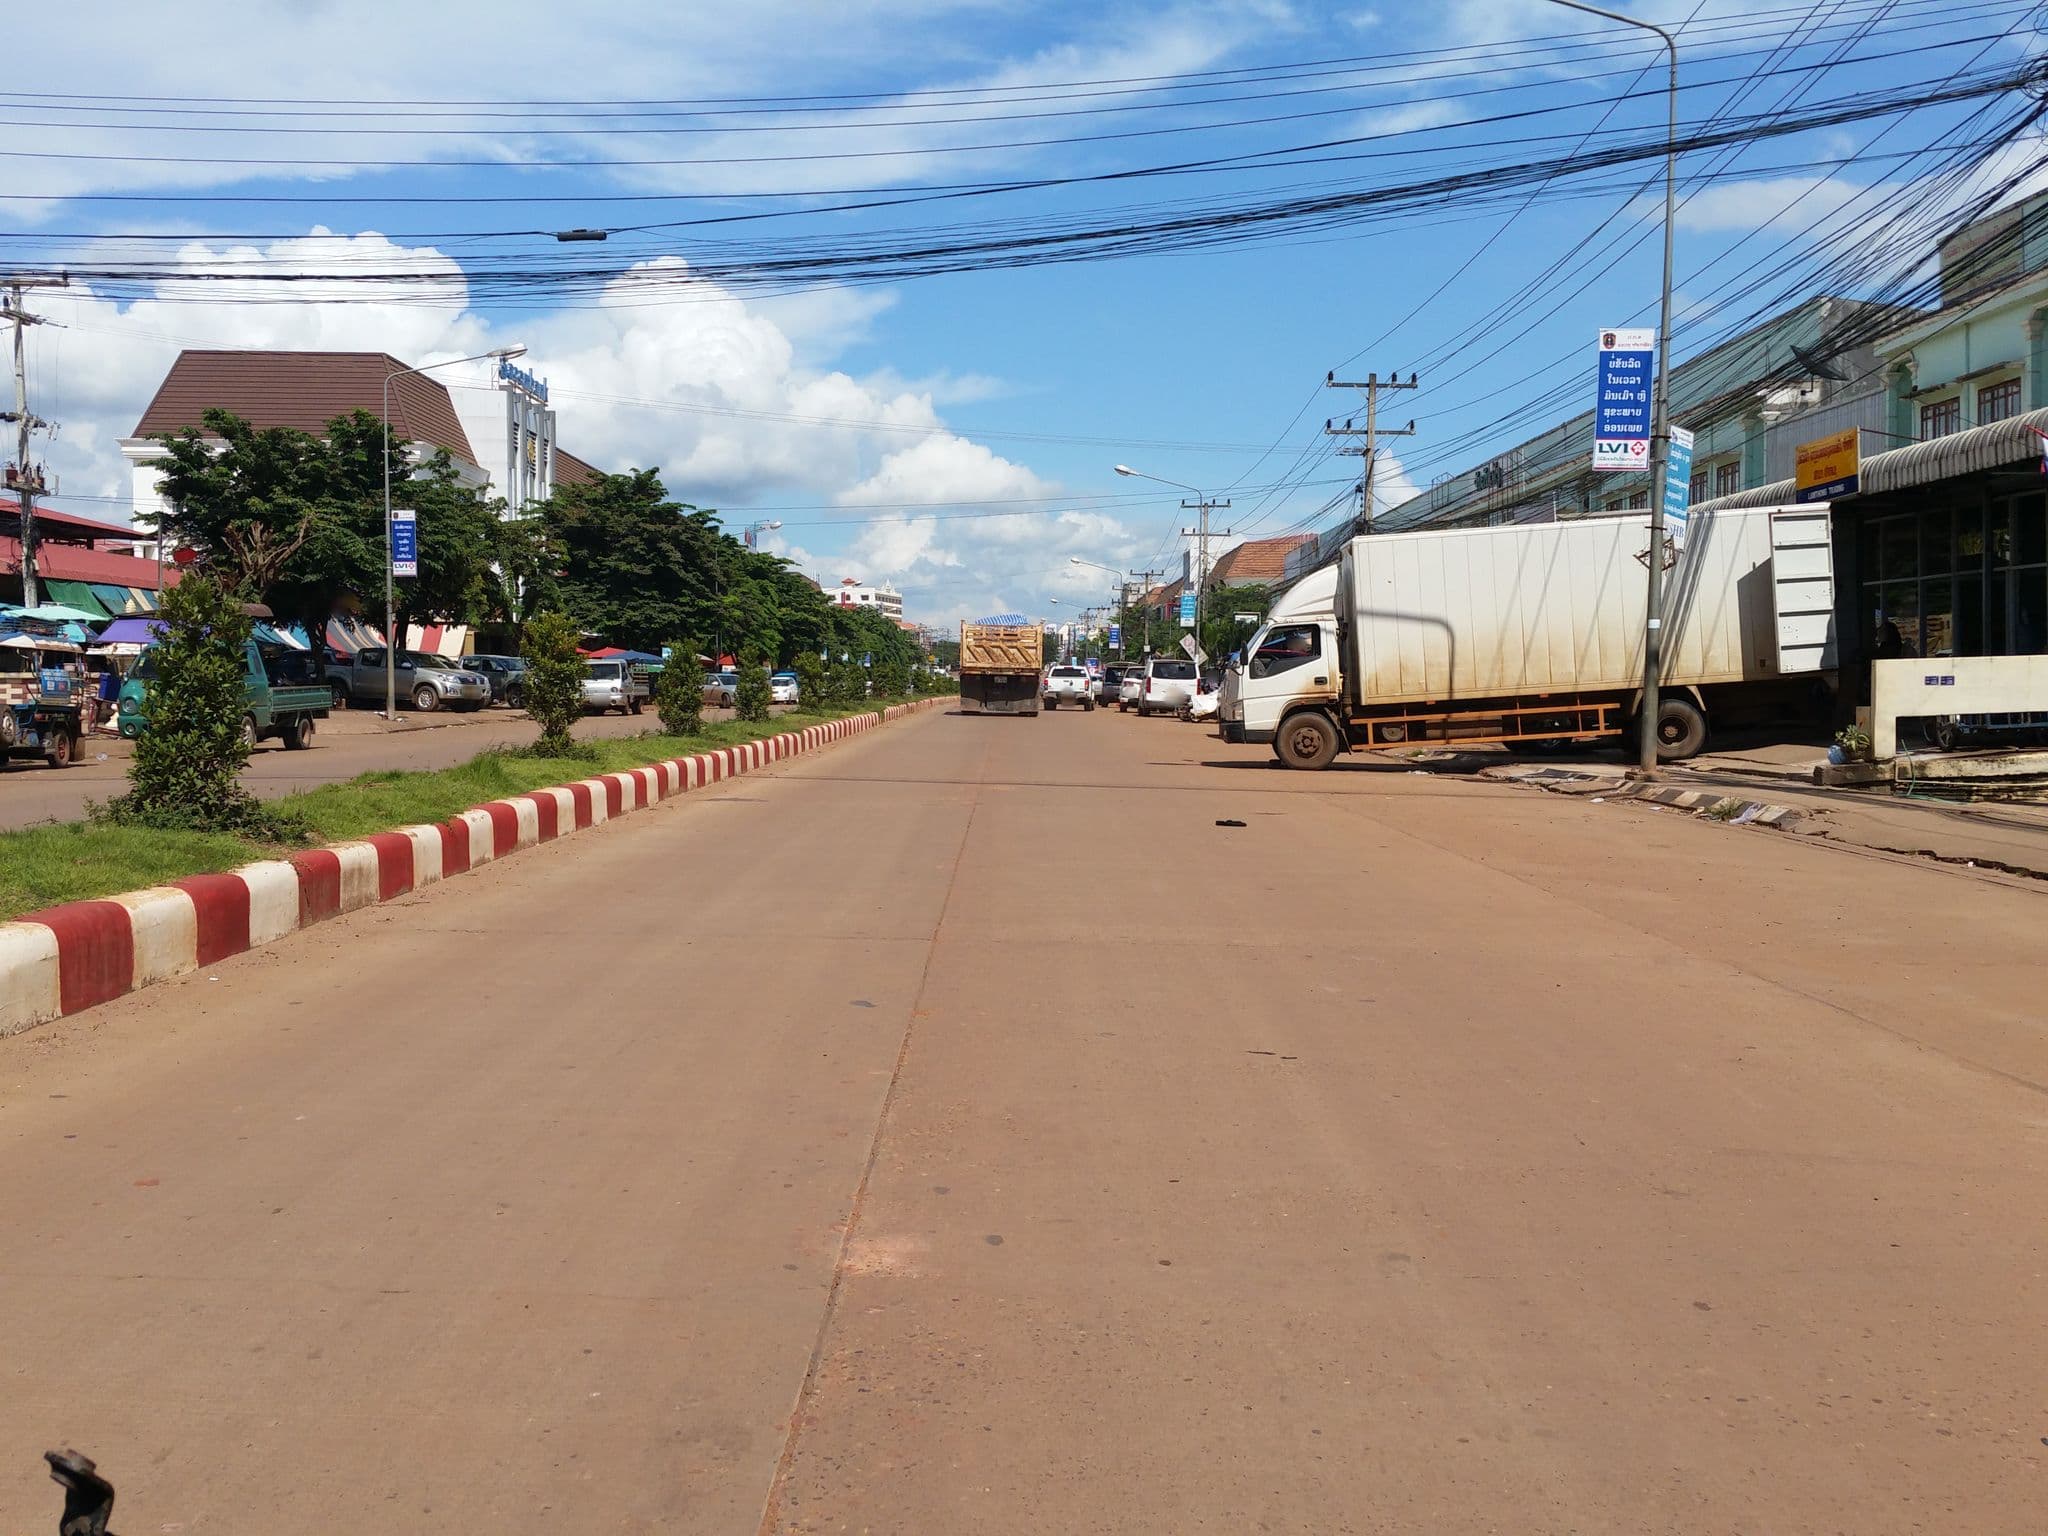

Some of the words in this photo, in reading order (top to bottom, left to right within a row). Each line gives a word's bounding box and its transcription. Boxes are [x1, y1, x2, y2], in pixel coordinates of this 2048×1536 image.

[1607, 373, 1641, 385] ໃນເວລາ
[1598, 443, 1629, 453] LVI
